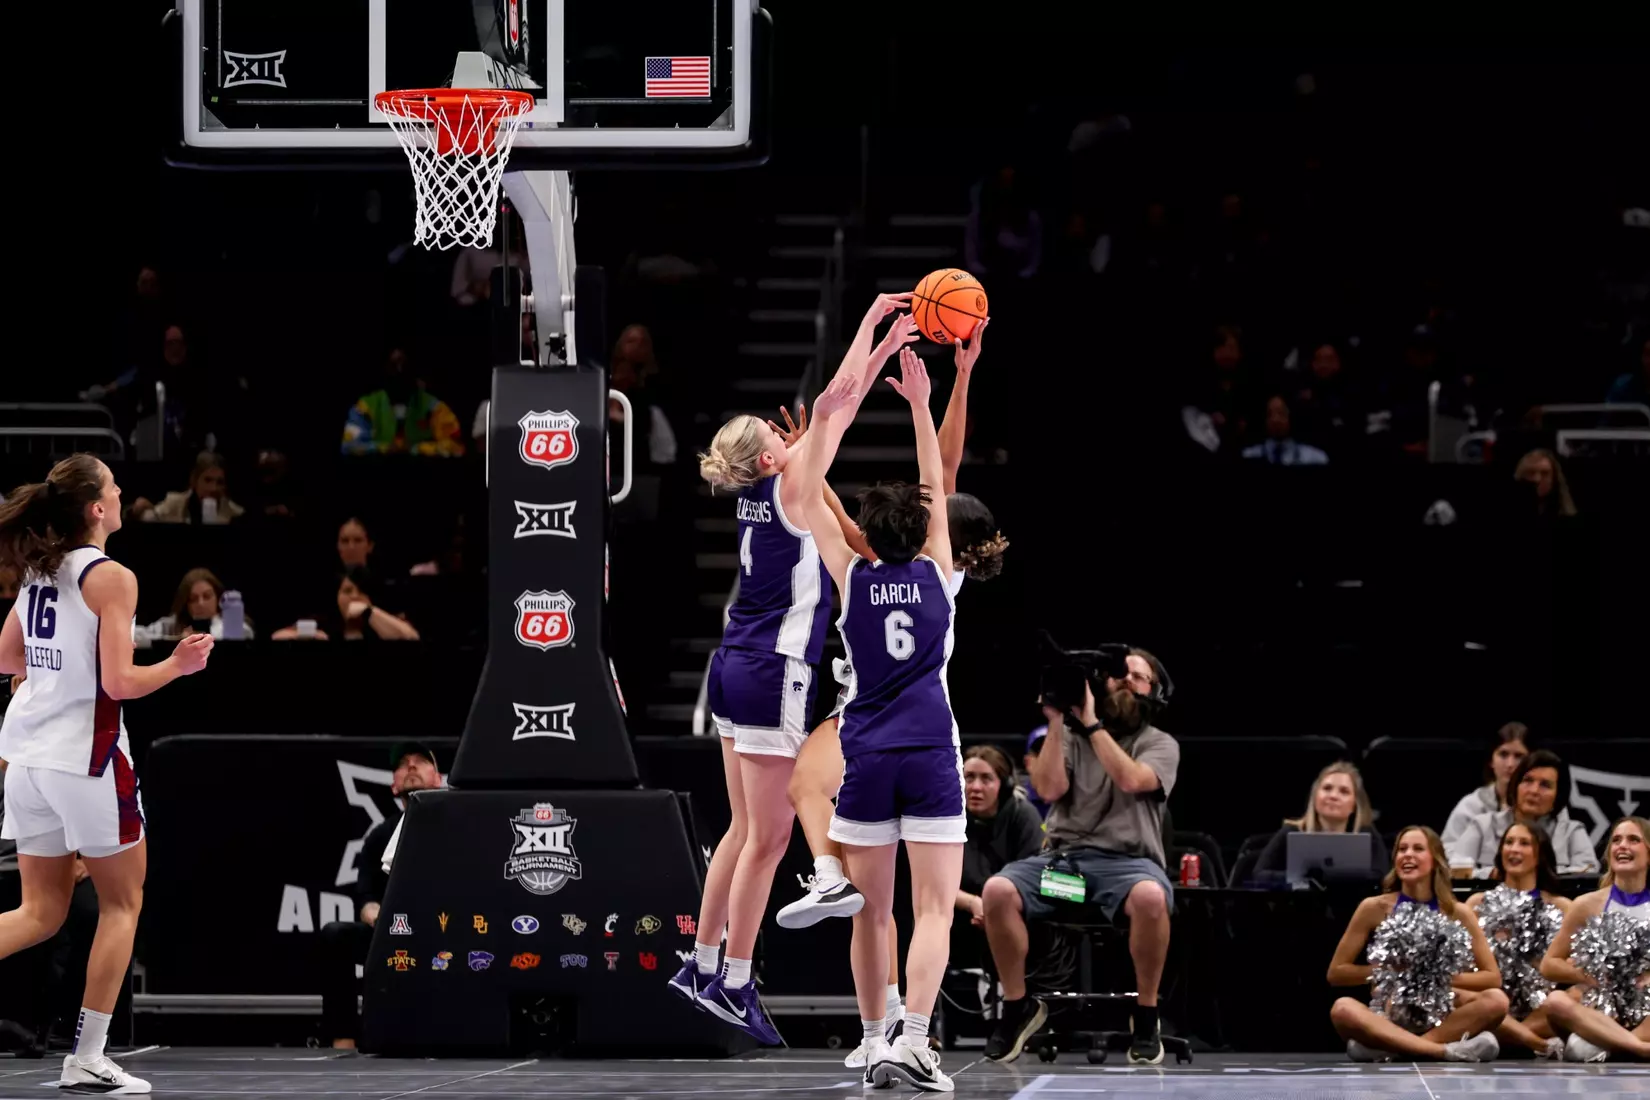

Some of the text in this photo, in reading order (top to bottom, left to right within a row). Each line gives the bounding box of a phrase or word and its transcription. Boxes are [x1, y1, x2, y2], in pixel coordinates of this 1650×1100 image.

[528, 420, 570, 429] PHILLIPS
[530, 433, 567, 456] 66
[524, 600, 566, 610] PHILLIPS
[869, 583, 922, 605] GARCIA
[27, 584, 59, 640] 16
[526, 615, 563, 637] 66
[884, 610, 916, 661] 6
[508, 862, 578, 875] TOURNAMENT
[511, 856, 576, 868] BASKETBALL
